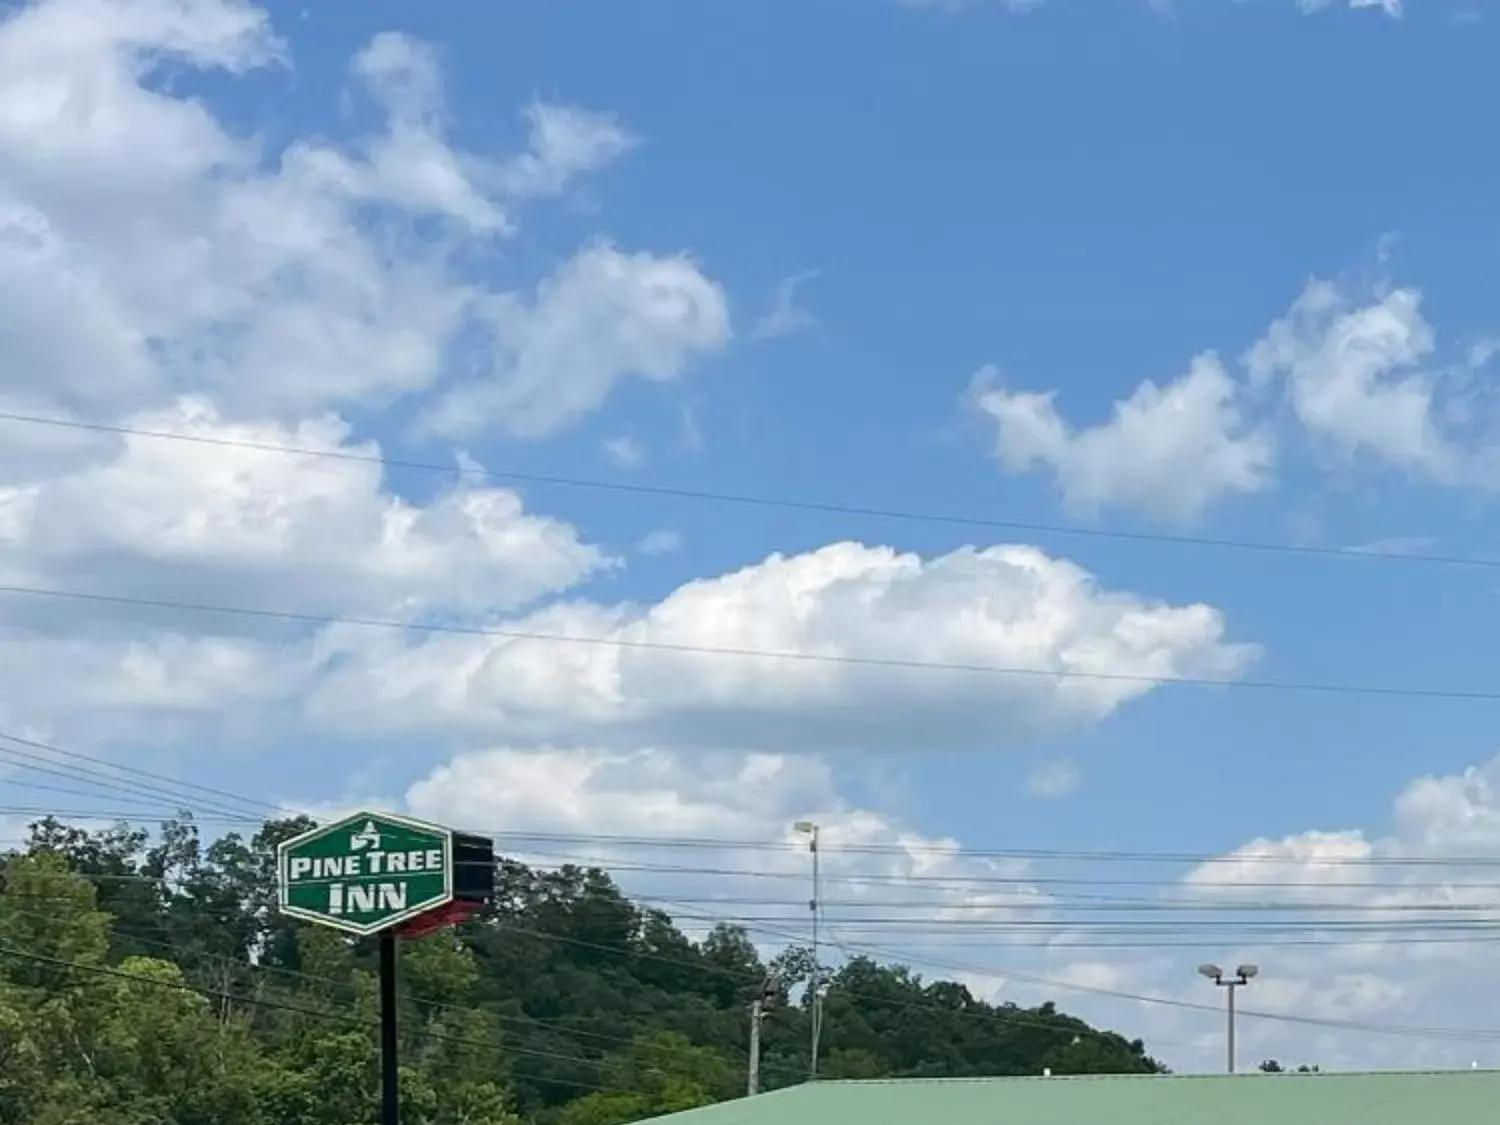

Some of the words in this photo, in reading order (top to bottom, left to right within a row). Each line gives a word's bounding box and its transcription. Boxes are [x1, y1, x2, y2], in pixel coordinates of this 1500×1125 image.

[290, 855, 360, 880] PINE
[366, 850, 442, 874] TREE
[328, 881, 407, 915] INN
